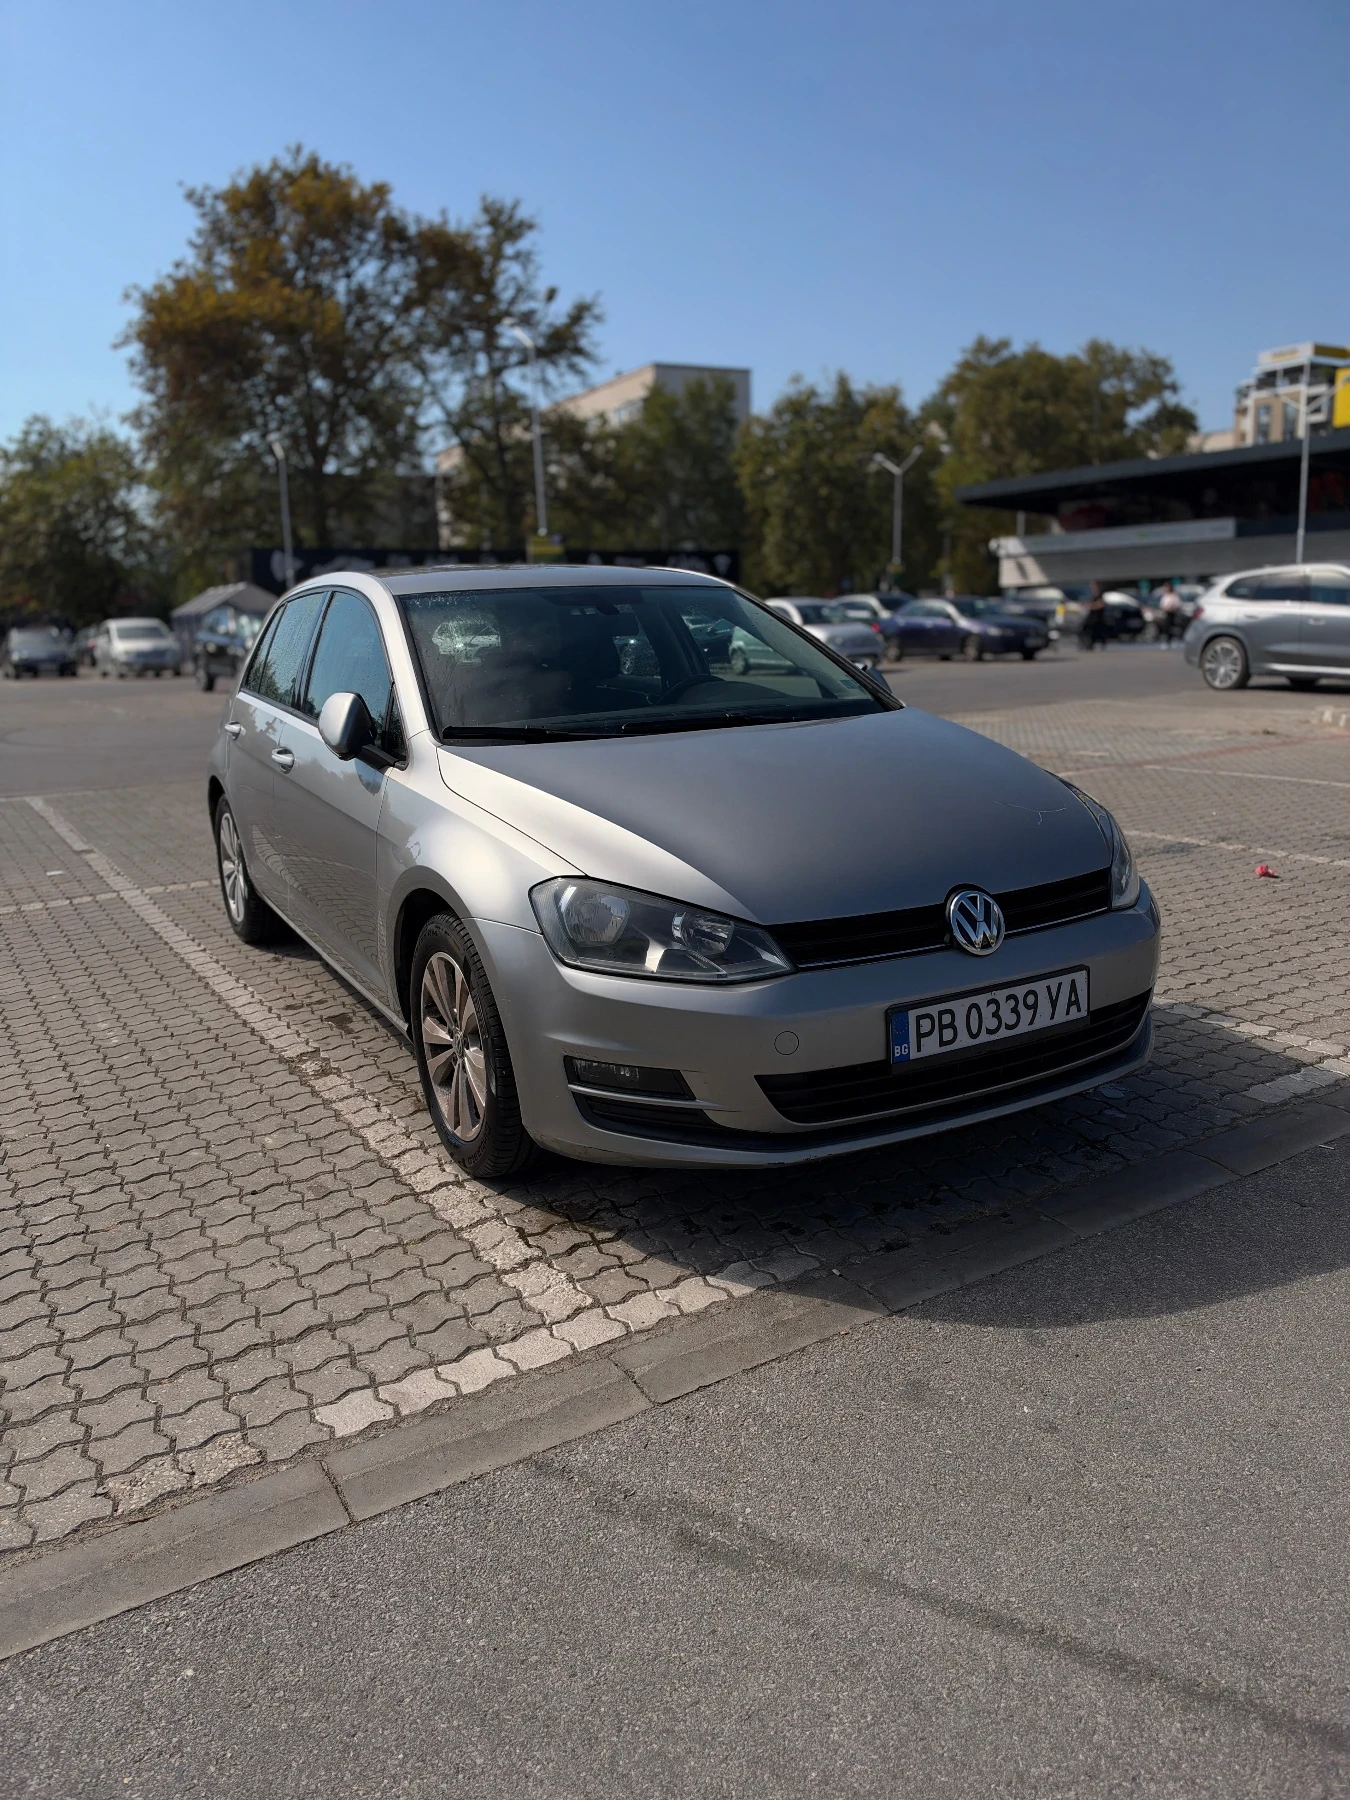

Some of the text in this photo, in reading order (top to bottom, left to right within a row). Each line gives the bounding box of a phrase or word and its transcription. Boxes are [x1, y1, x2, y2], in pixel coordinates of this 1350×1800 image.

[951, 892, 1003, 953] VW
[915, 978, 1082, 1053] PB 0339 YA
[894, 1043, 909, 1057] BG
